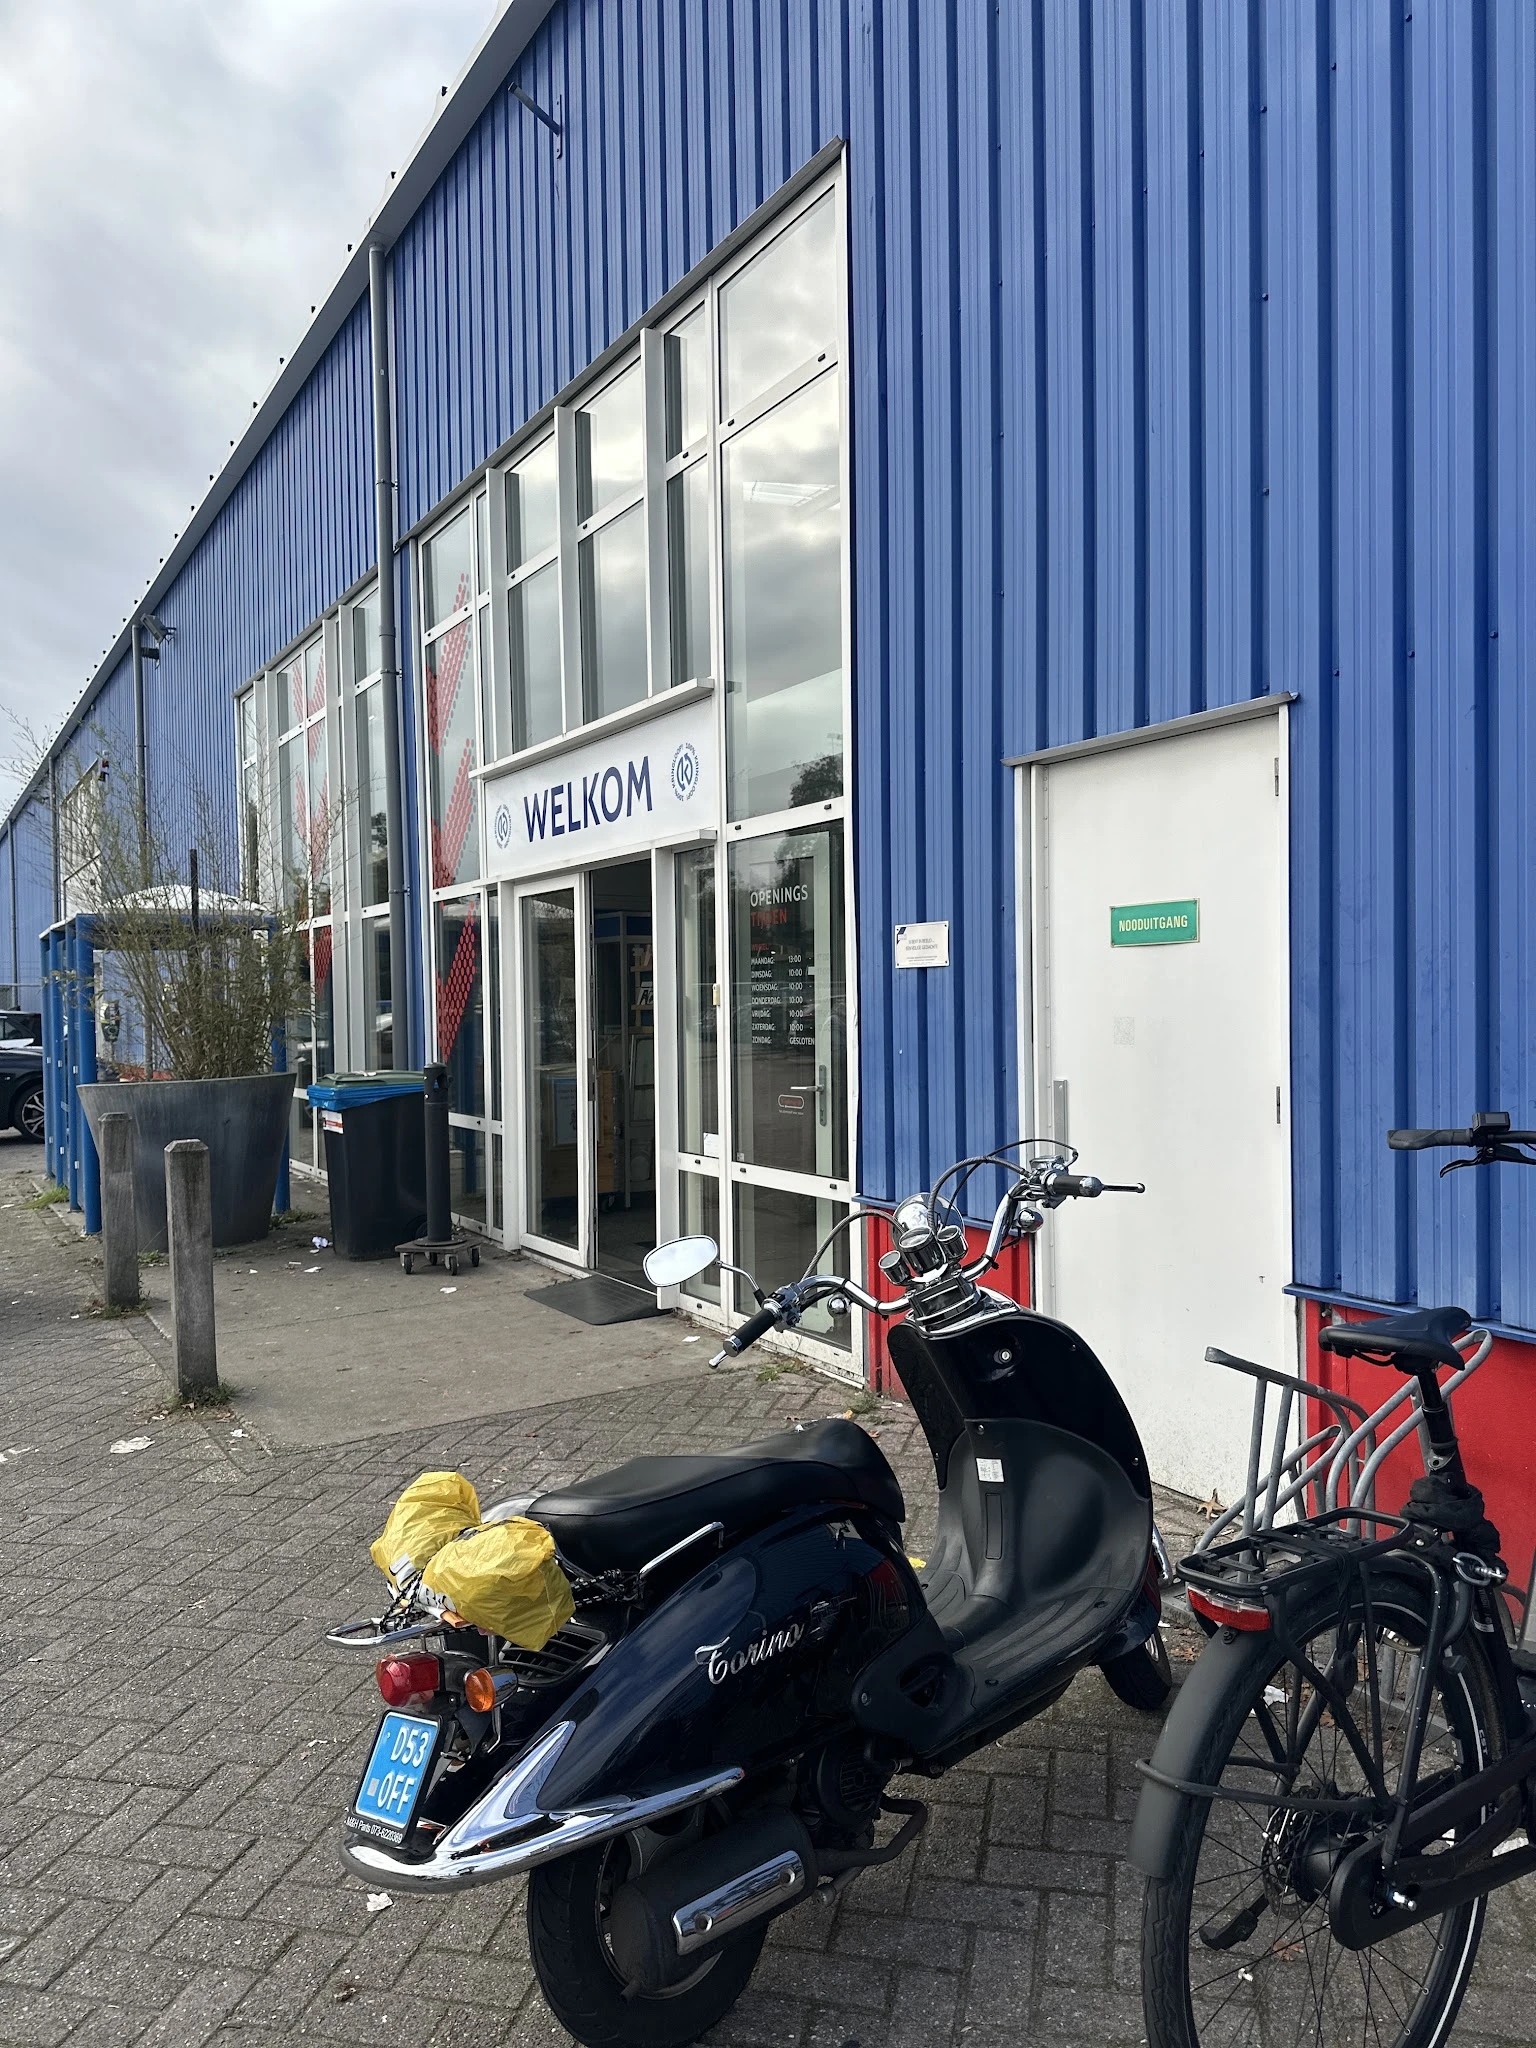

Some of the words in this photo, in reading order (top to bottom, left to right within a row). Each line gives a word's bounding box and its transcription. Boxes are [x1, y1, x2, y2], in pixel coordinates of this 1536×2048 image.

[523, 756, 653, 843] WELKOM
[750, 884, 808, 907] OPENINGS
[1119, 915, 1188, 932] NOODUITGANG
[788, 954, 802, 963] 13:00
[788, 968, 803, 977] 10:00
[788, 982, 803, 991] 10:00
[788, 995, 804, 1004] 10:00
[789, 1009, 804, 1018] 10:00
[789, 1023, 804, 1032] 10:00
[789, 1036, 815, 1046] GESLOTEN
[694, 1623, 805, 1685] Torino
[390, 1726, 429, 1768] D53
[377, 1770, 415, 1814] OFF
